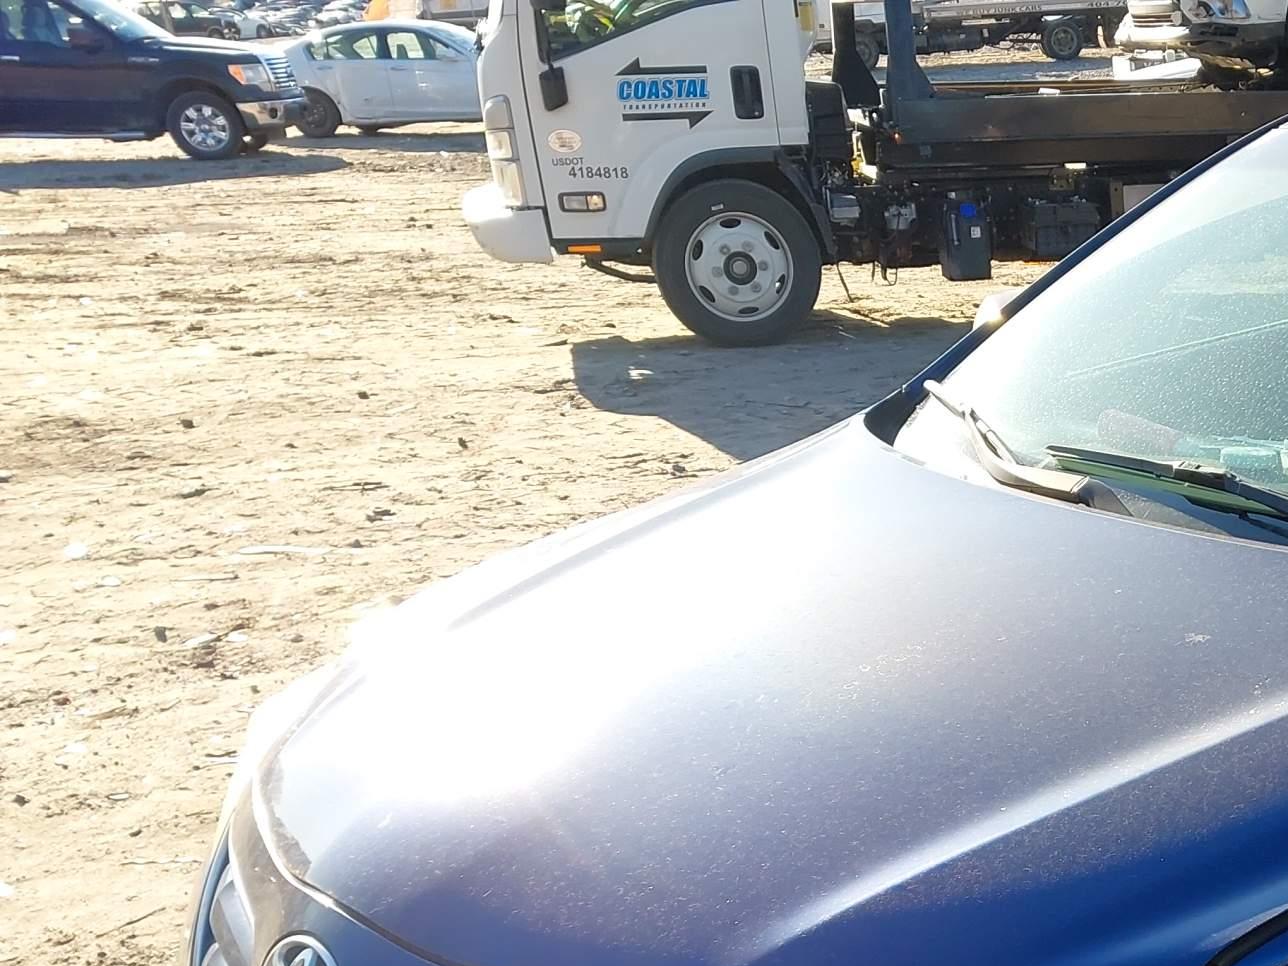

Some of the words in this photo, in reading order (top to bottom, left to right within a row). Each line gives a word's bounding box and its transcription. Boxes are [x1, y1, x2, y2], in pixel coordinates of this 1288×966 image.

[617, 78, 710, 101] COASTAL
[623, 102, 707, 110] TRANSPORTATION
[551, 157, 585, 167] USDOT
[568, 166, 629, 179] 4184818
